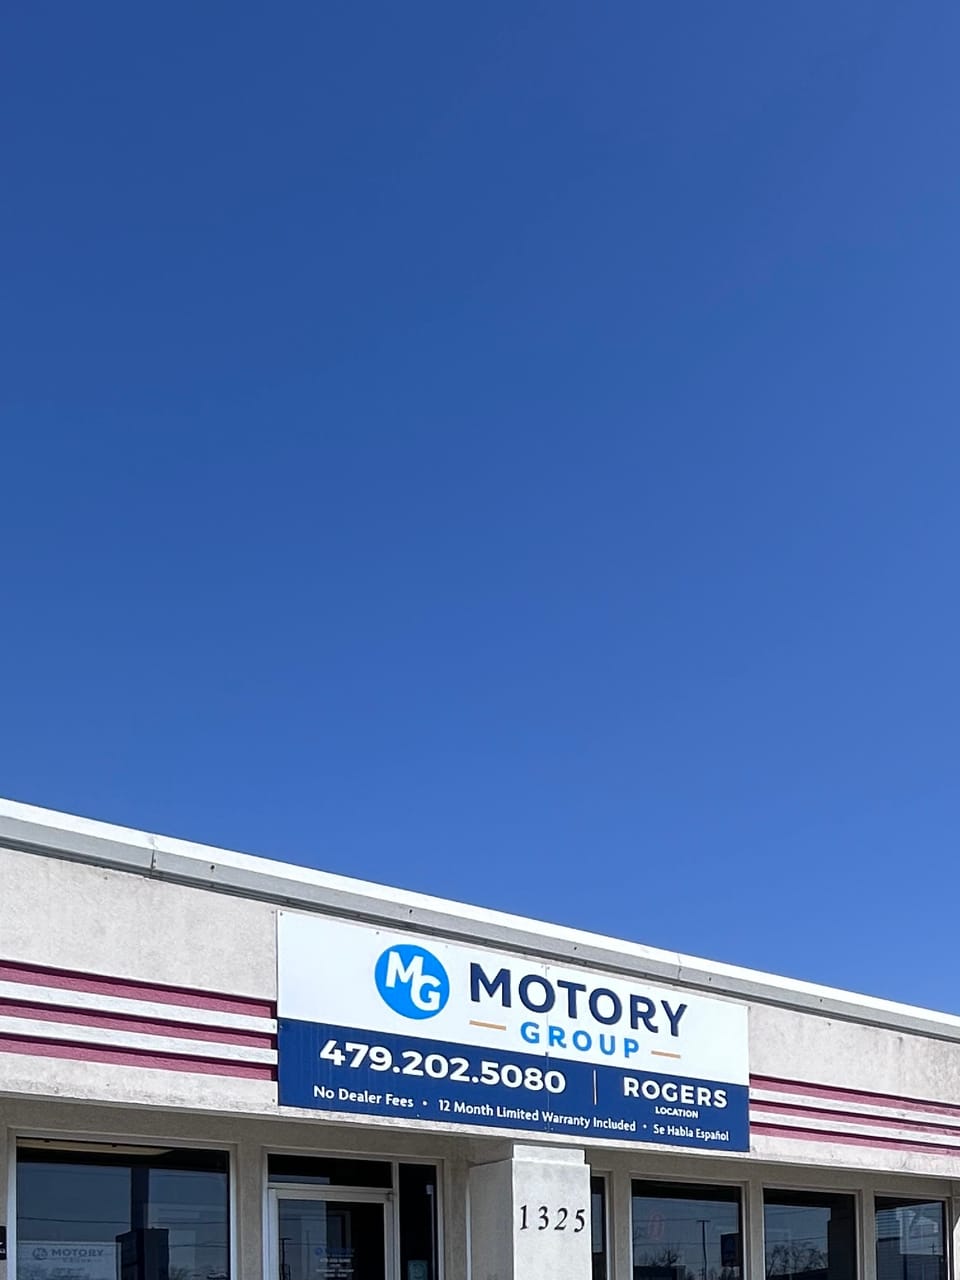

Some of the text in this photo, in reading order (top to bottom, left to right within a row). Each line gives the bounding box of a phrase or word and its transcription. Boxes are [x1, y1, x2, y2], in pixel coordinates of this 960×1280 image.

[385, 950, 442, 1012] MG
[469, 961, 688, 1037] MOTORY
[520, 1021, 640, 1058] GROUP
[319, 1040, 566, 1094] 479.202.5080
[313, 1085, 414, 1107] No Dealer Fees
[623, 1076, 728, 1108] ROGERS
[438, 1099, 636, 1132] 12 Month Limited Warranty Included
[655, 1106, 699, 1119] LOCATION
[653, 1124, 730, 1141] Se Habla Español
[519, 1204, 585, 1233] 1325
